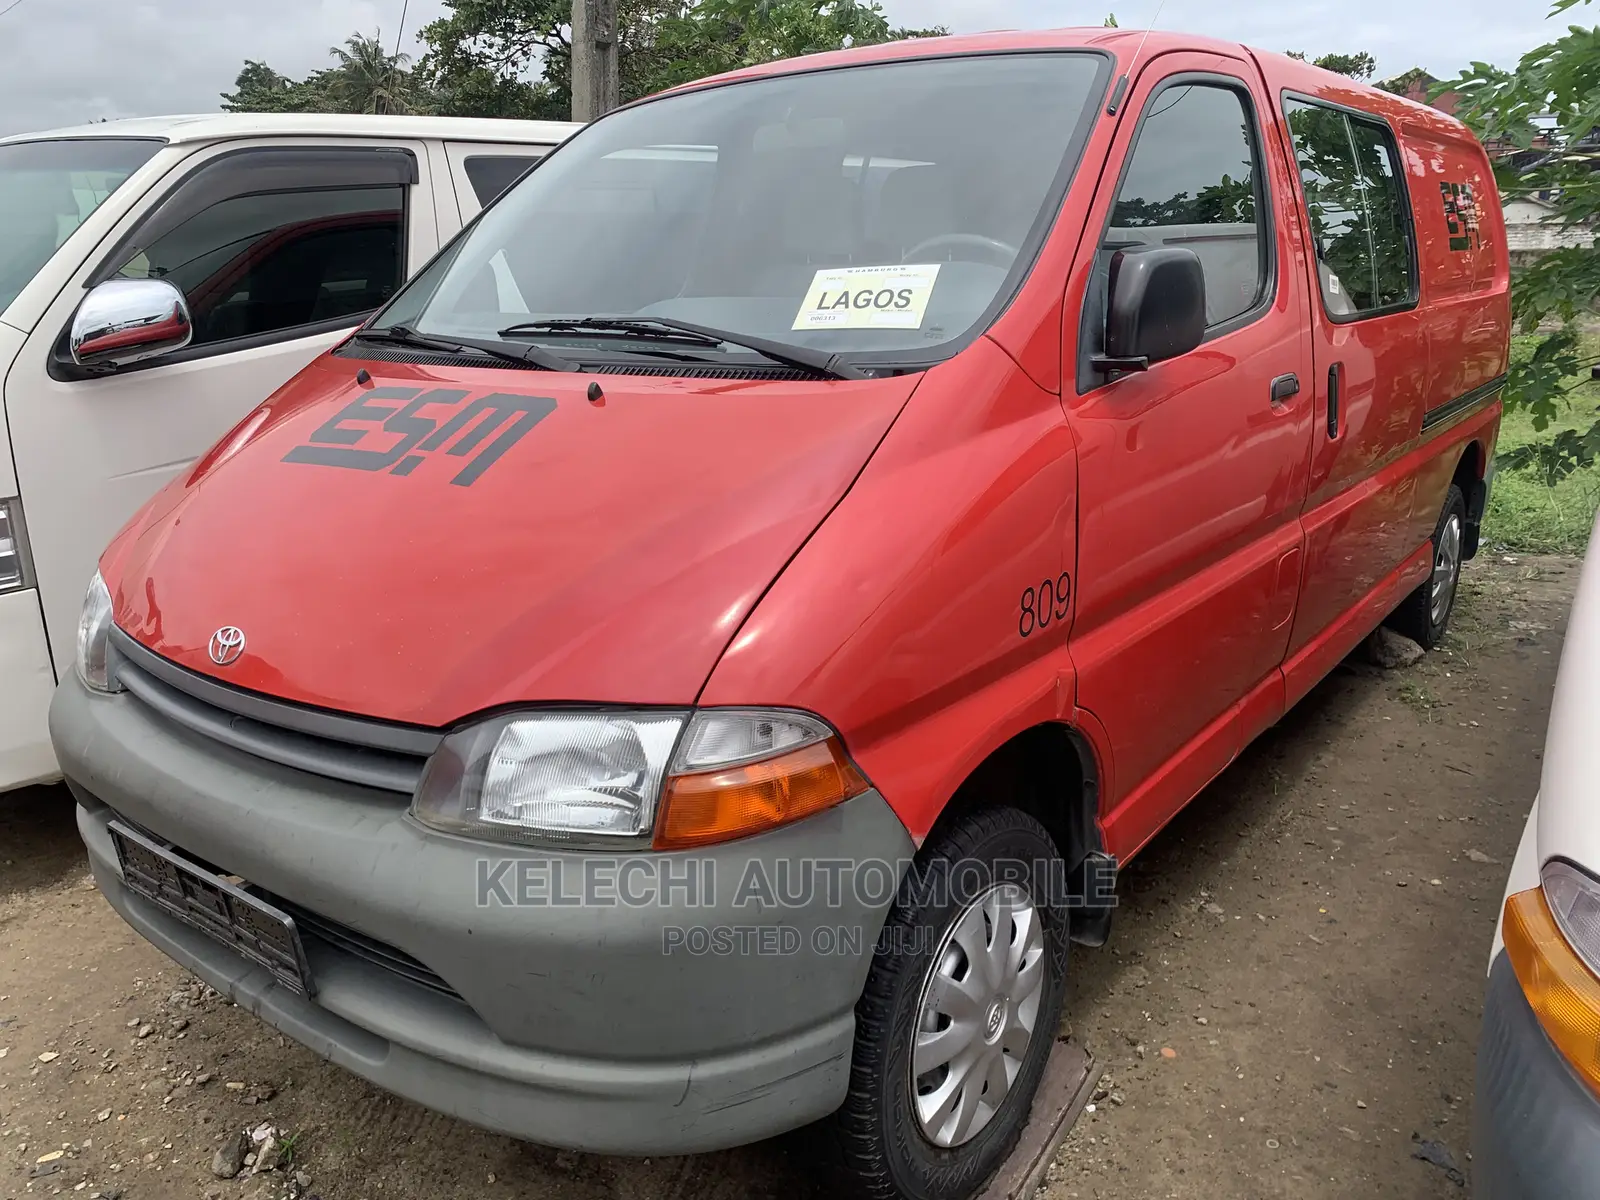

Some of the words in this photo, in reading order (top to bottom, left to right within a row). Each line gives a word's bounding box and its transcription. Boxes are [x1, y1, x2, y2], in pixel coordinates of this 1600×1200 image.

[816, 289, 913, 310] LAGOS
[281, 387, 558, 487] ESM
[1019, 571, 1071, 637] 809
